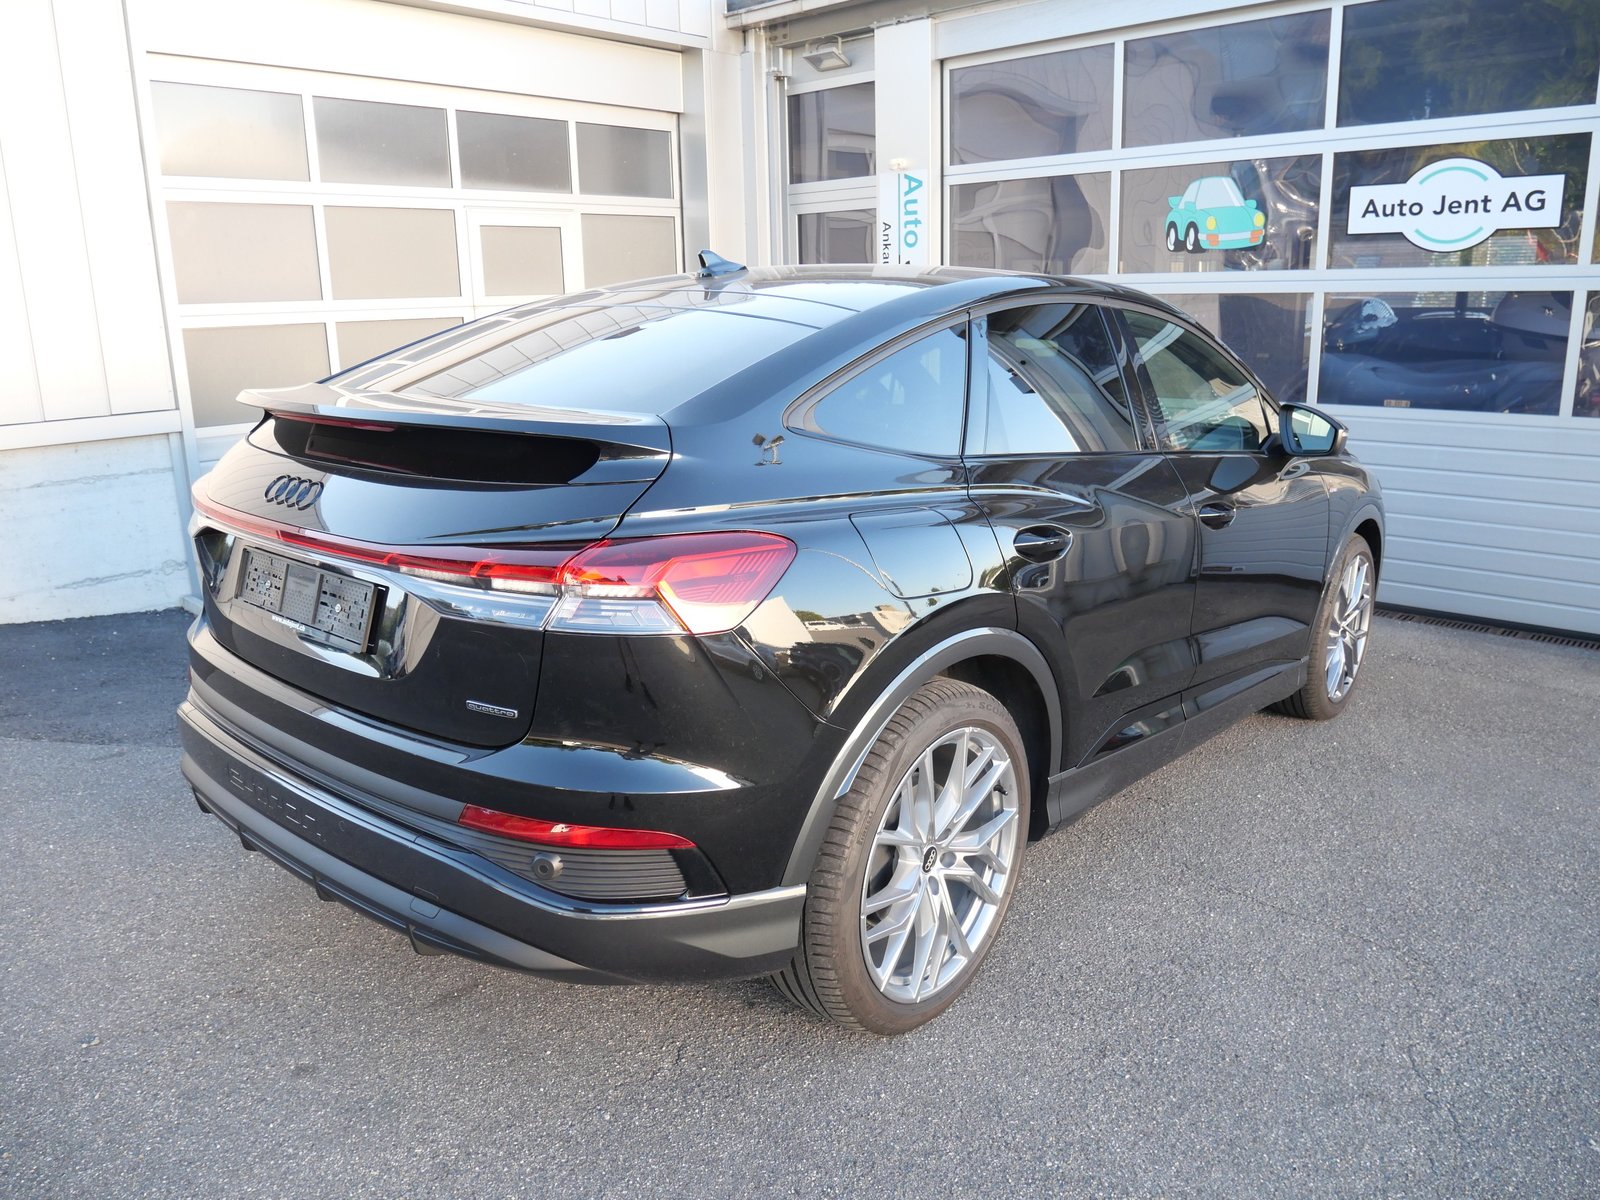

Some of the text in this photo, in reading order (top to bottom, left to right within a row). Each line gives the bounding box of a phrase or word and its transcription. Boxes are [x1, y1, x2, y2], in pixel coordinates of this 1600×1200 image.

[904, 173, 923, 249] Auto
[1361, 189, 1546, 218] Auto Jent AG
[467, 702, 515, 718] quattro
